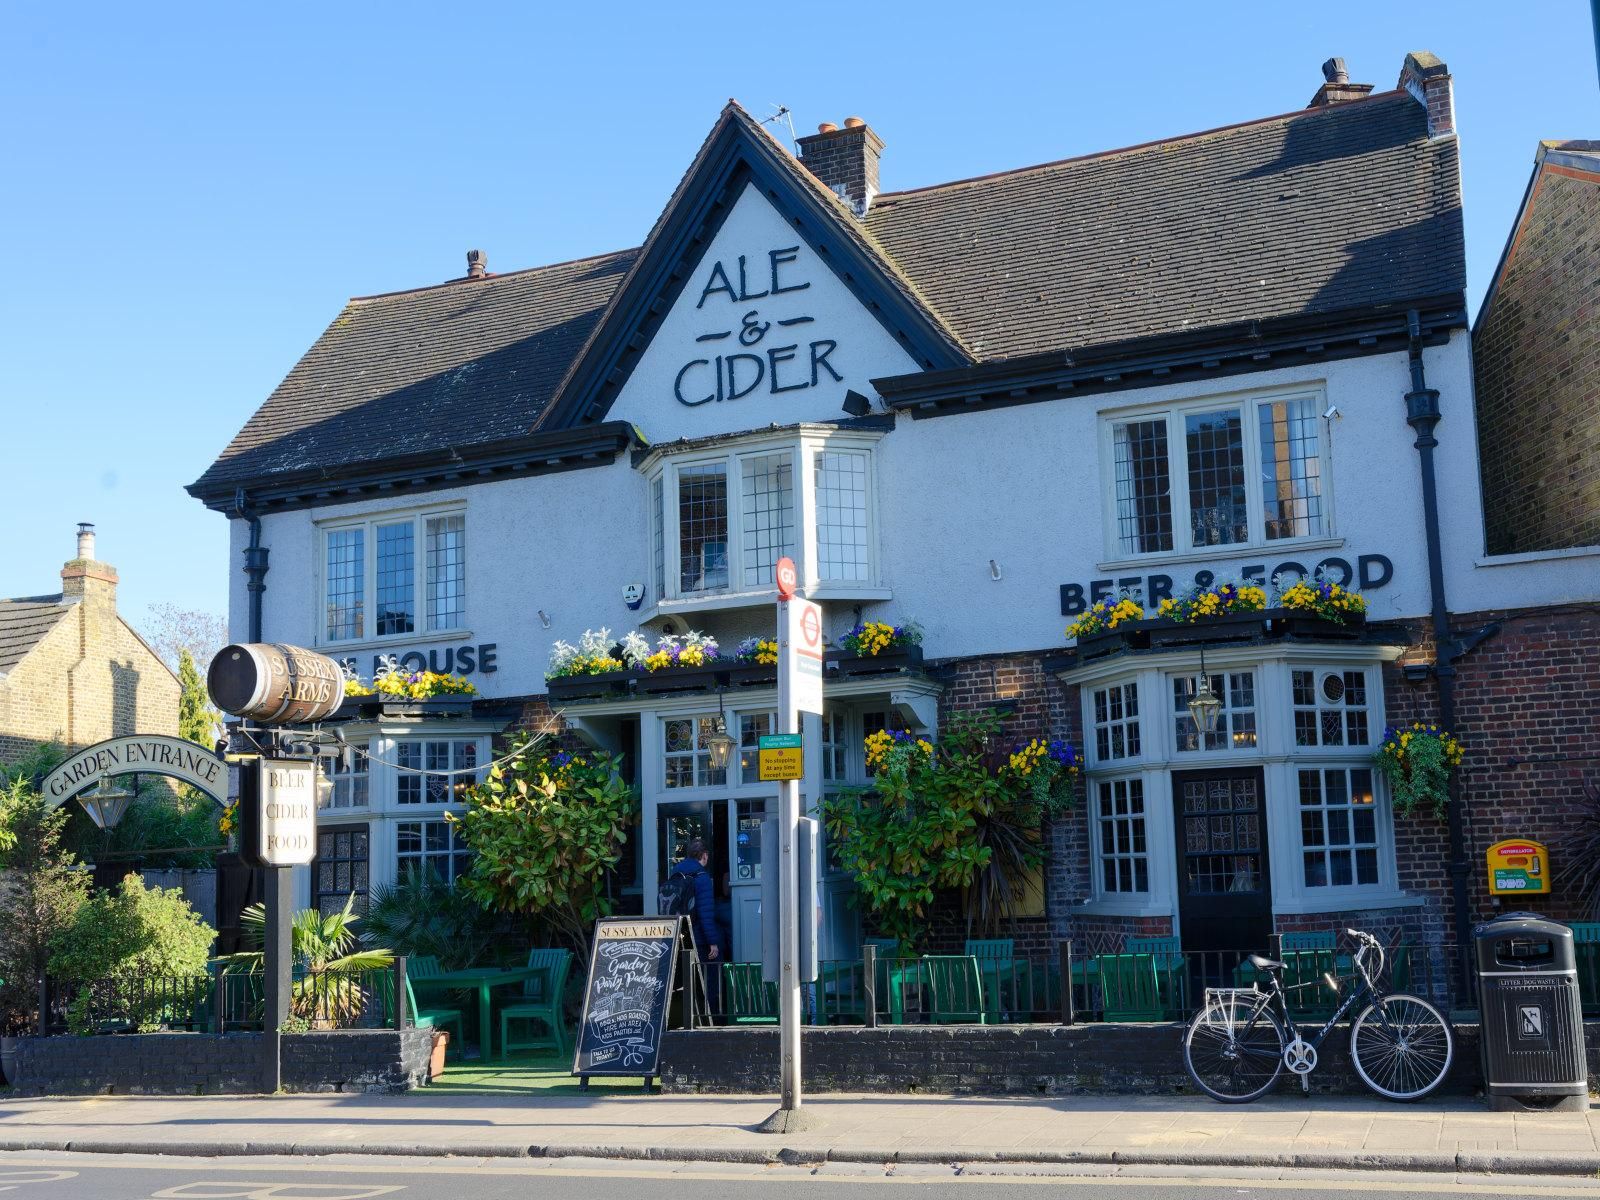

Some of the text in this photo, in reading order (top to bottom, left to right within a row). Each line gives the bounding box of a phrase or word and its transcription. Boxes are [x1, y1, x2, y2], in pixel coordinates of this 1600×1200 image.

[696, 245, 811, 309] ALE
[738, 310, 771, 346] &
[674, 339, 843, 407] CIDER
[1059, 574, 1173, 616] BEER
[1241, 553, 1394, 592] FOOD
[271, 656, 337, 681] SUSSEX
[278, 680, 332, 703] ARMS
[50, 743, 221, 797] GARDEN ENTRANCE
[269, 772, 305, 788] BEER
[265, 803, 308, 819] CIDER
[267, 835, 308, 850] FOOD
[601, 926, 672, 938] SUSSEX ARMS
[608, 957, 652, 976] Garden
[594, 976, 624, 993] Party
[604, 1024, 618, 1033] HIRE
[627, 1020, 642, 1028] AREA
[616, 1013, 628, 1021] HOG
